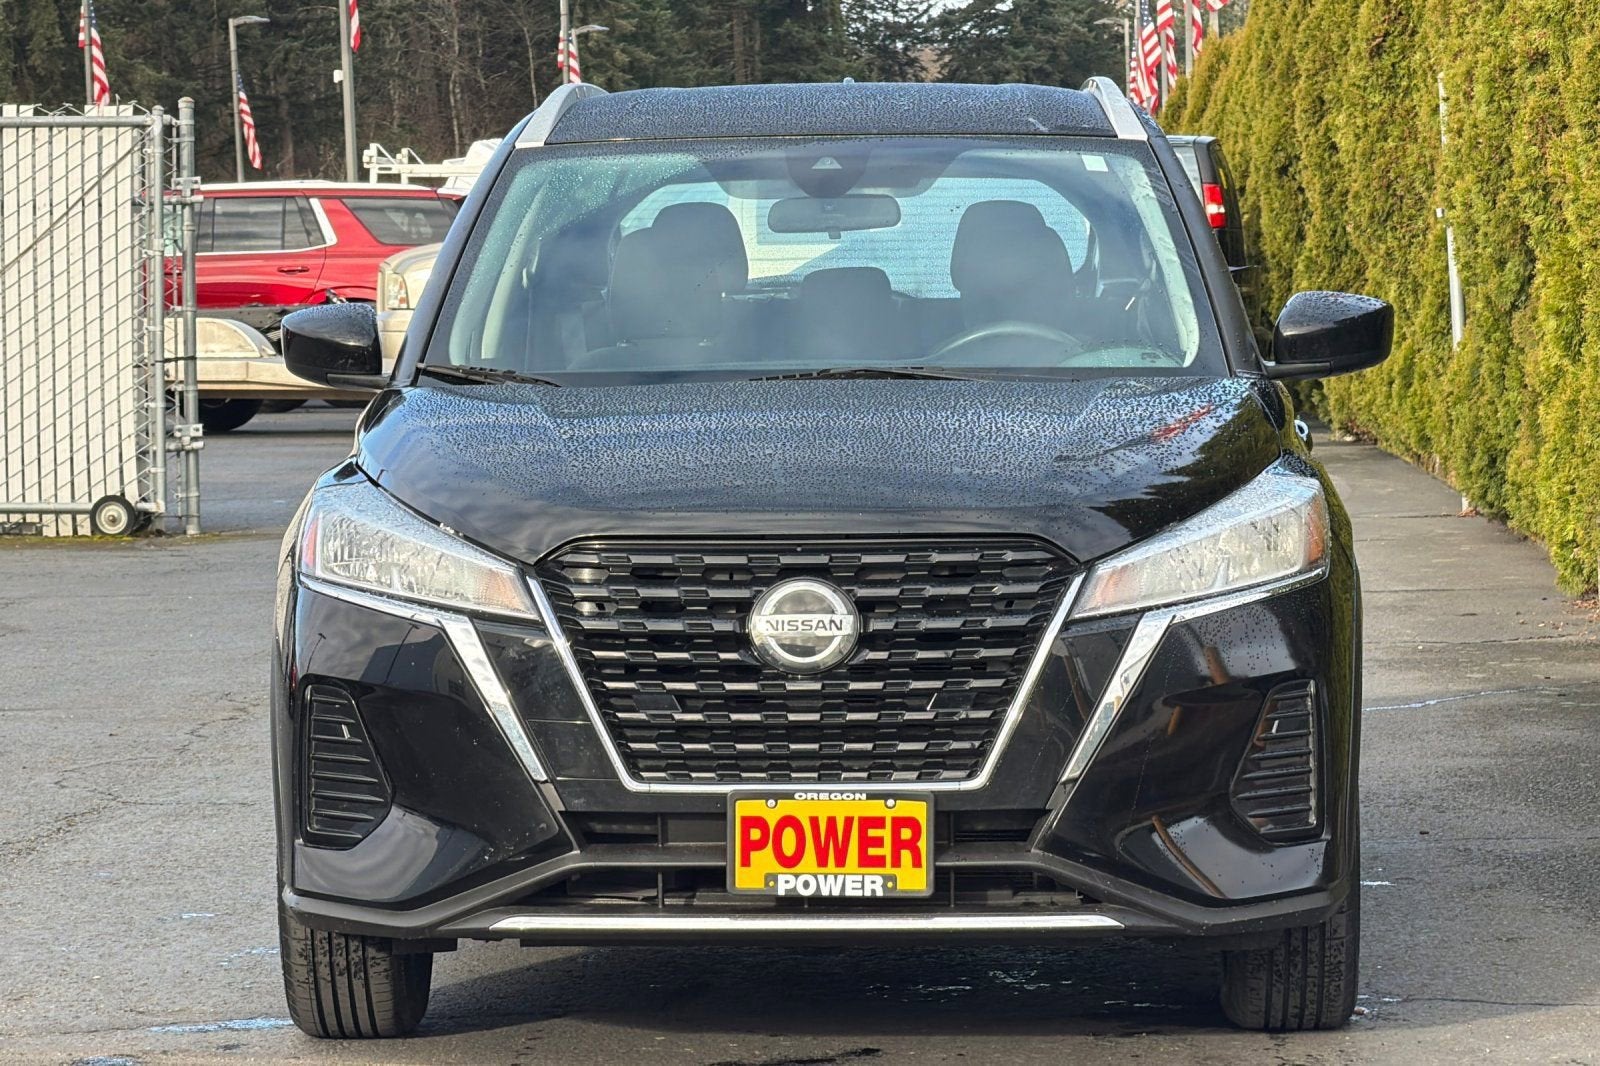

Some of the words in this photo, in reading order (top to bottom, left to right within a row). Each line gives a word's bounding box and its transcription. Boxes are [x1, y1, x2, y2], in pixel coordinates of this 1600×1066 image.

[765, 618, 843, 632] NISSAN
[794, 792, 867, 801] OREGON
[740, 815, 923, 869] POWER
[777, 874, 884, 896] POWER
